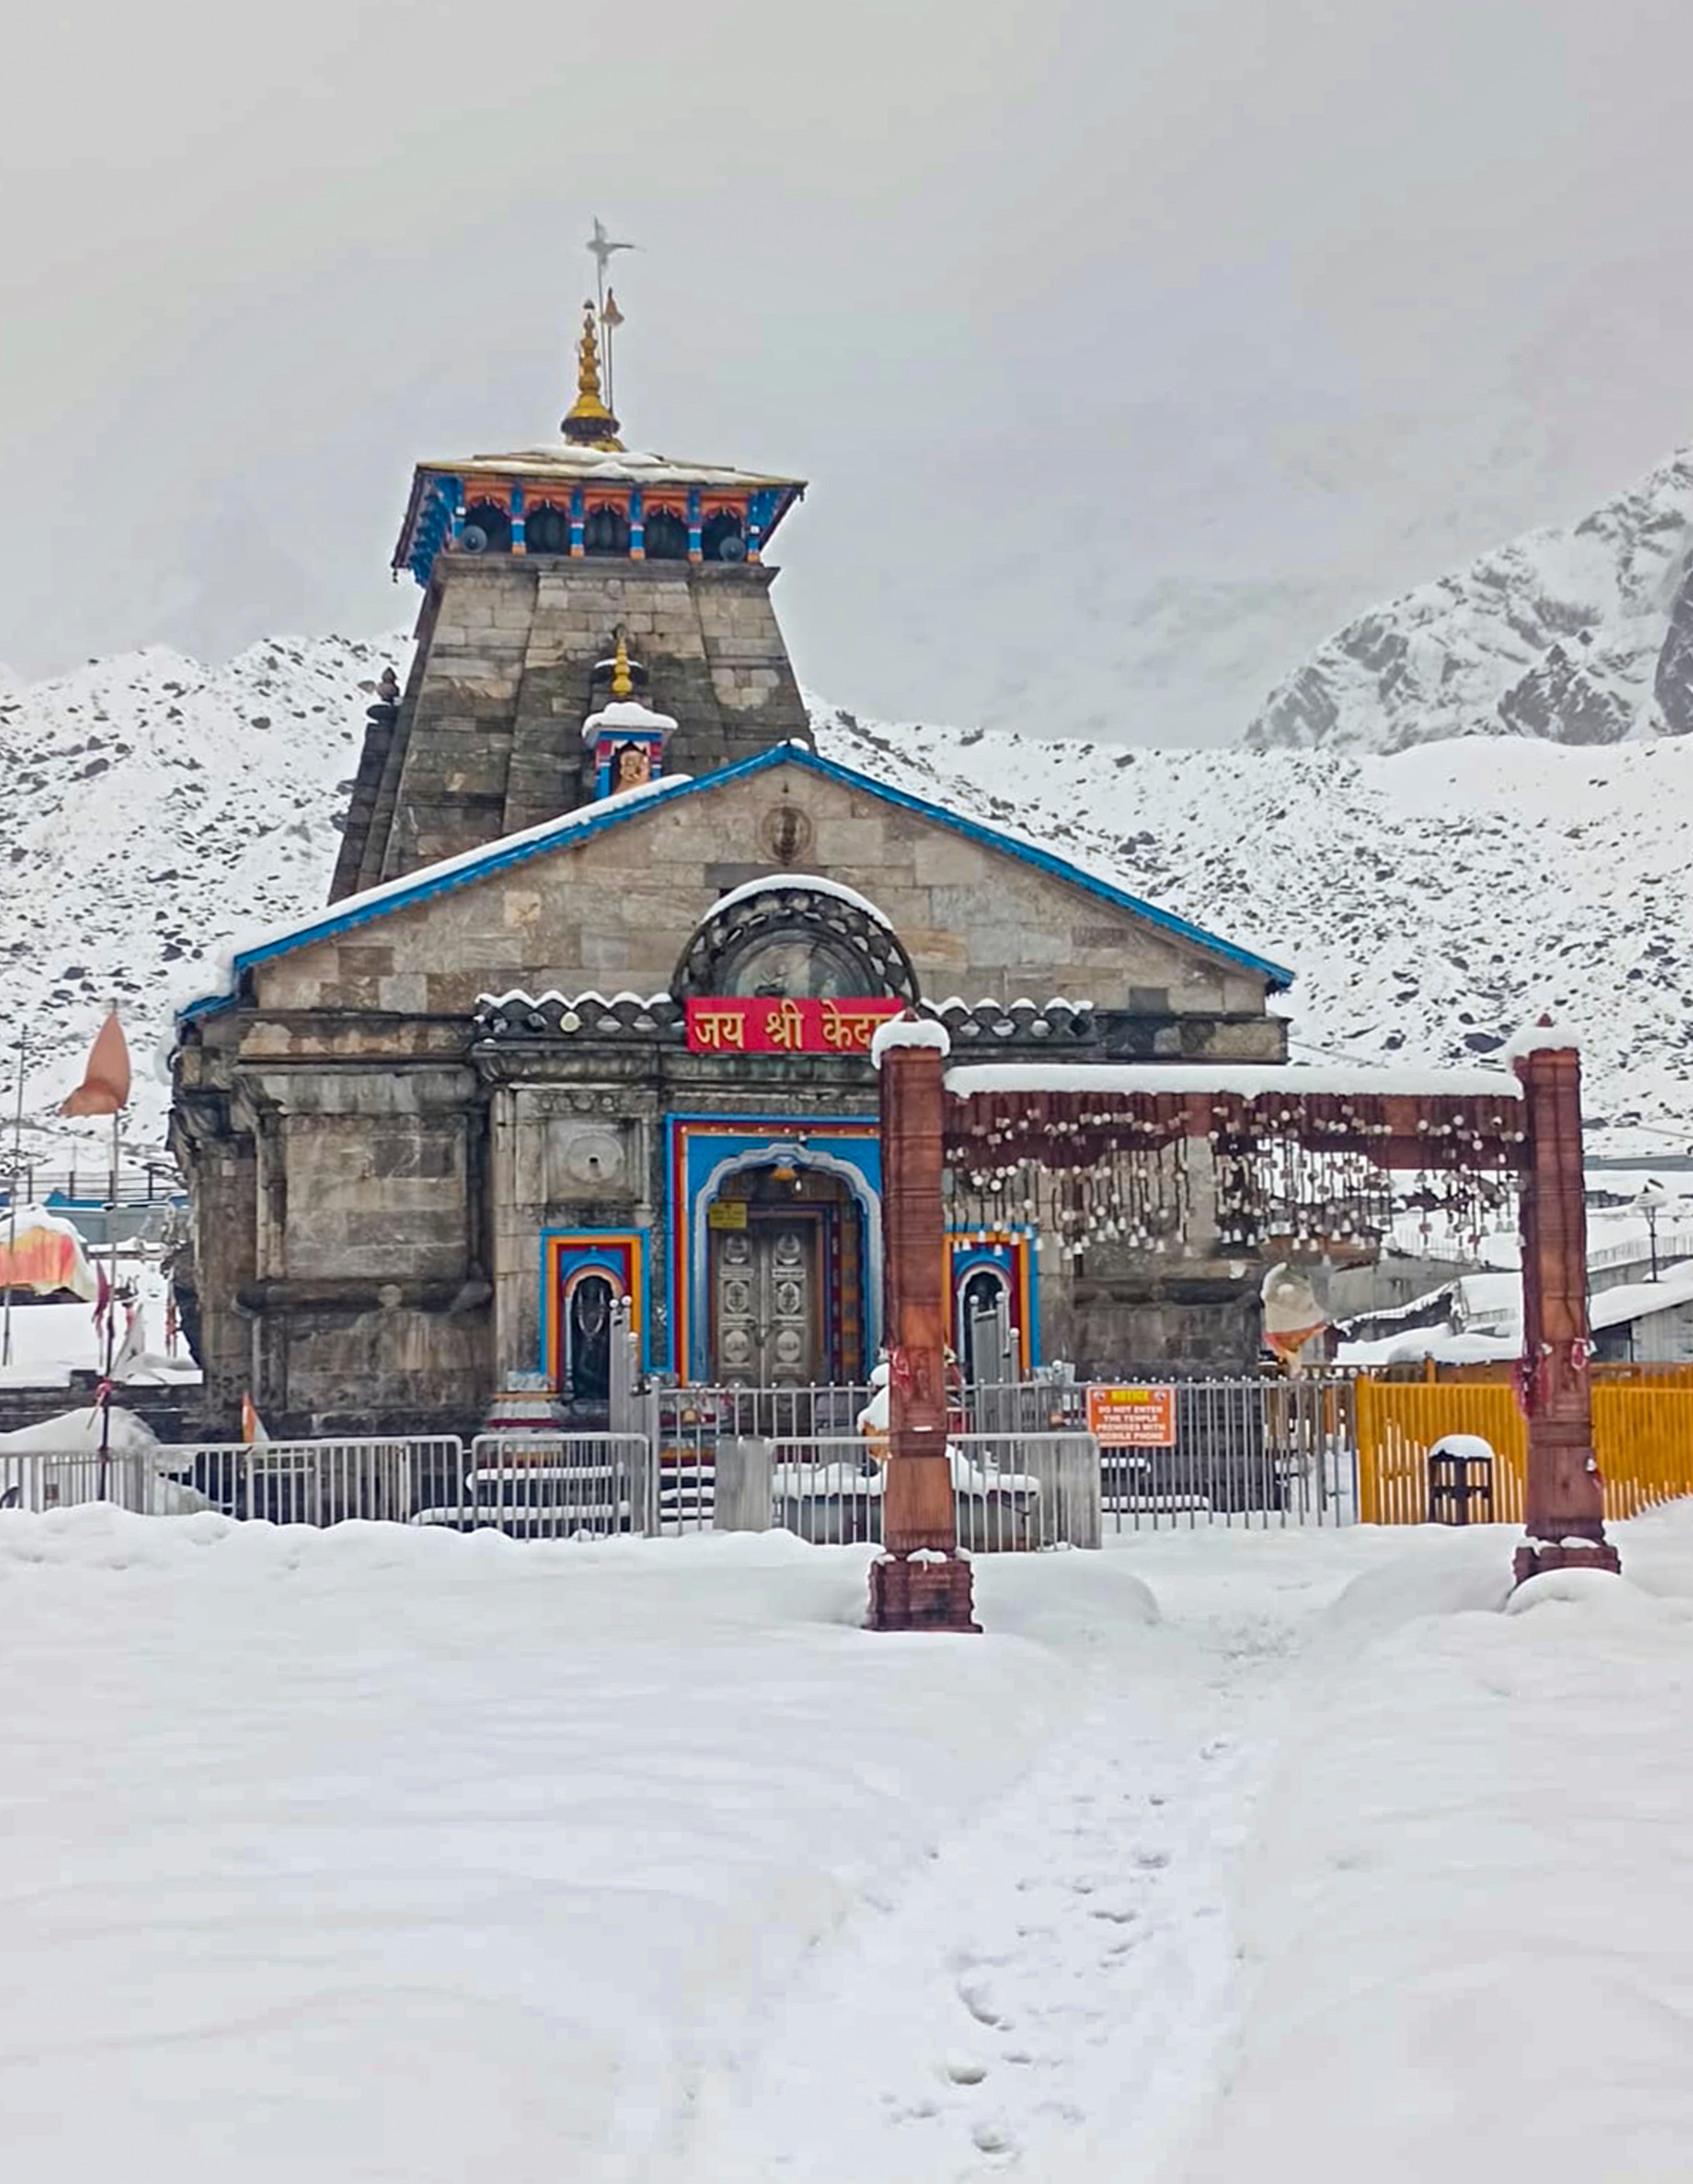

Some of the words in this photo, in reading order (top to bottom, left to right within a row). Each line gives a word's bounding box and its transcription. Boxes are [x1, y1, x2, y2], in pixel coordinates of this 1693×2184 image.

[695, 1012, 745, 1049] जय
[765, 998, 804, 1049] श्री
[1112, 1390, 1148, 1400] NOTICE
